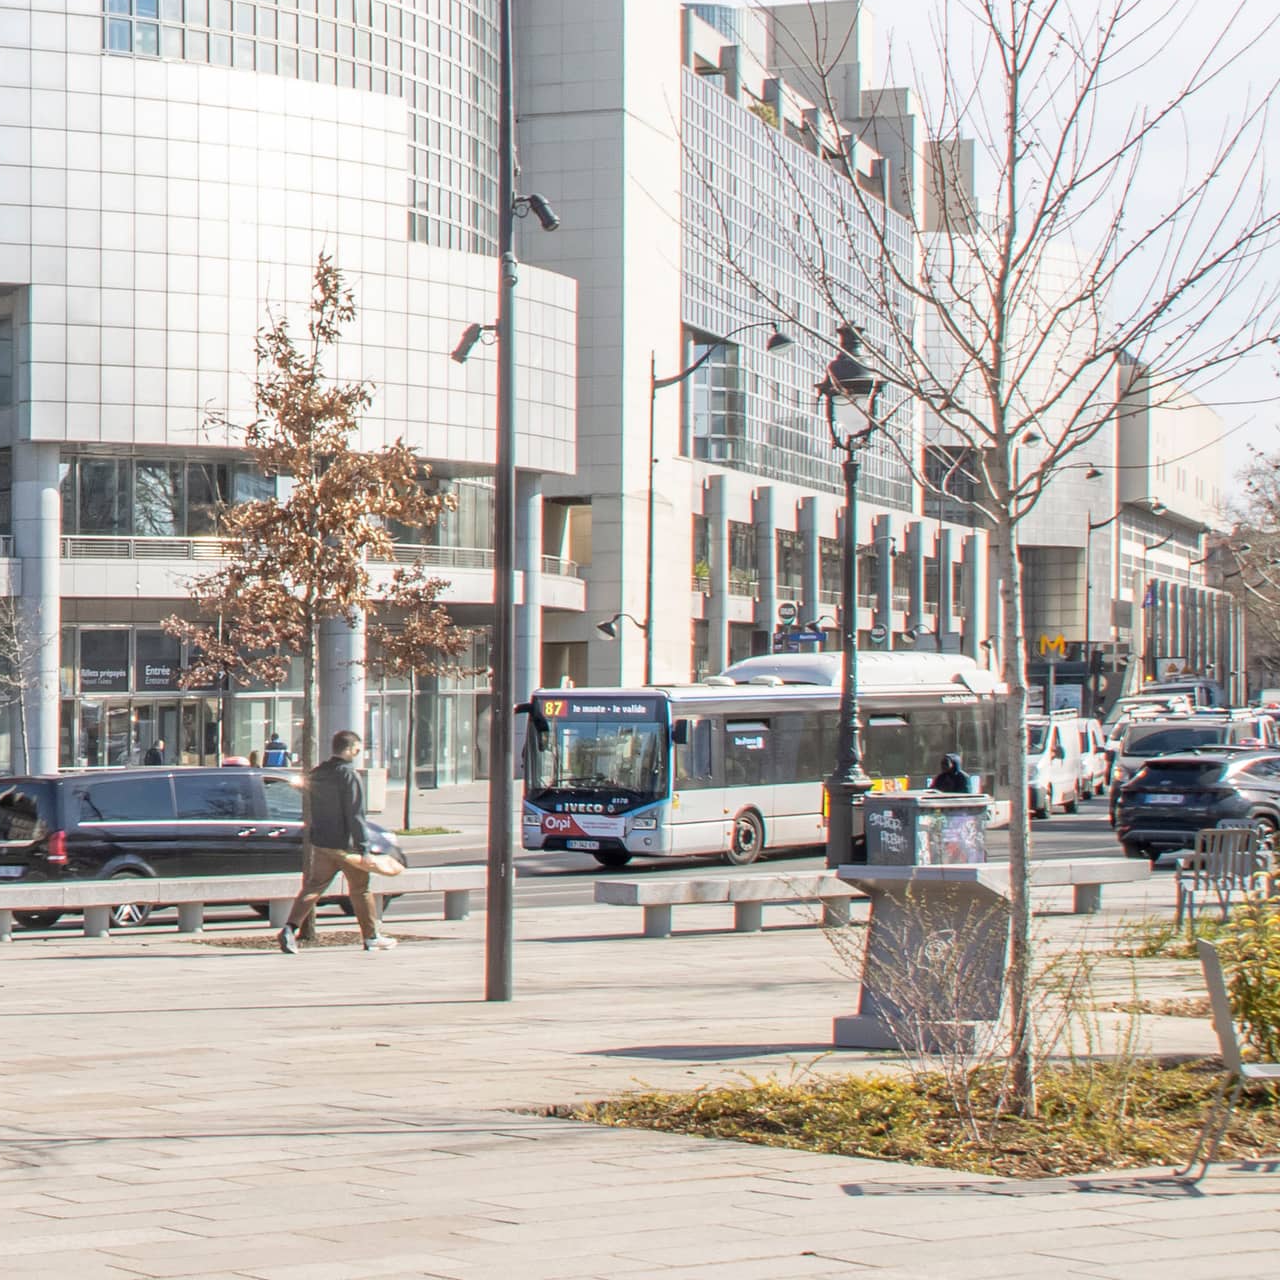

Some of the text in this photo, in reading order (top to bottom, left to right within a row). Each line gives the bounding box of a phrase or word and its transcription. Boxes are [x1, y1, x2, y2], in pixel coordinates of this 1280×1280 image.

[1041, 634, 1065, 657] M
[145, 664, 170, 676] Entrée
[544, 700, 562, 716] 87
[622, 704, 646, 713] valide
[564, 802, 603, 813] IVECO
[545, 816, 571, 831] Orpi
